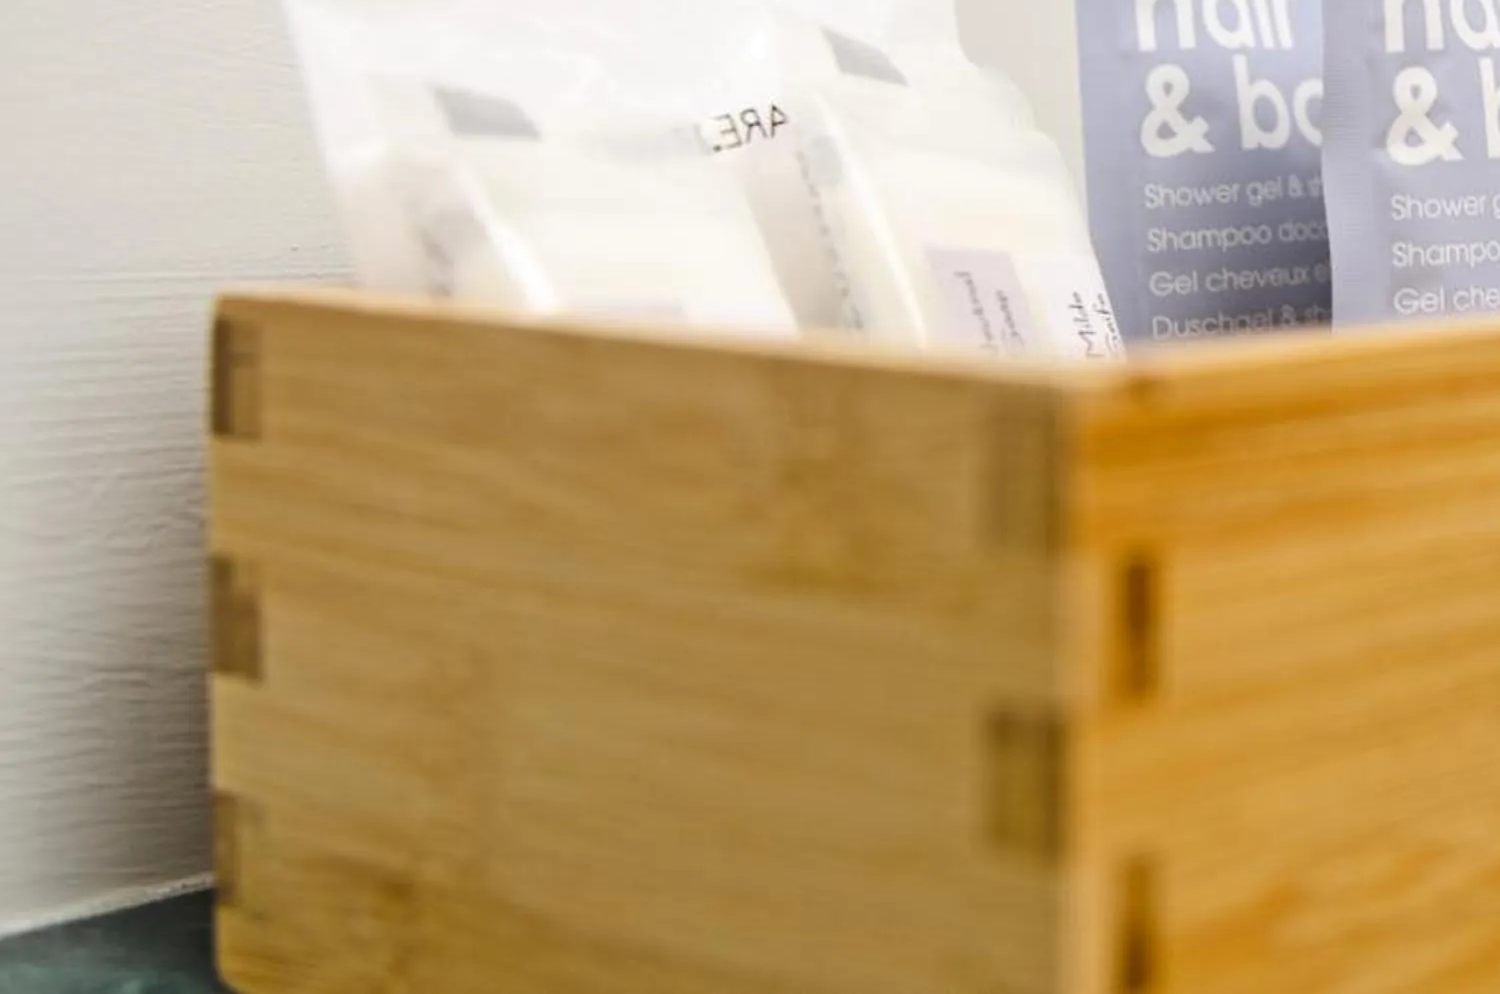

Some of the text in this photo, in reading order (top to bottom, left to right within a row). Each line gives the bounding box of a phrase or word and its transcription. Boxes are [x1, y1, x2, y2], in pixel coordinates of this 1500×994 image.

[1141, 54, 1323, 157] & bo
[1387, 66, 1466, 166] &
[1144, 183, 1241, 208] Shower
[1246, 175, 1282, 207] gel
[1288, 174, 1304, 198] &
[1391, 193, 1486, 221] Shower
[1147, 223, 1273, 253] Shampoo
[1149, 270, 1198, 297] Gel
[1204, 265, 1310, 292] cheveux
[1393, 287, 1446, 314] Gel
